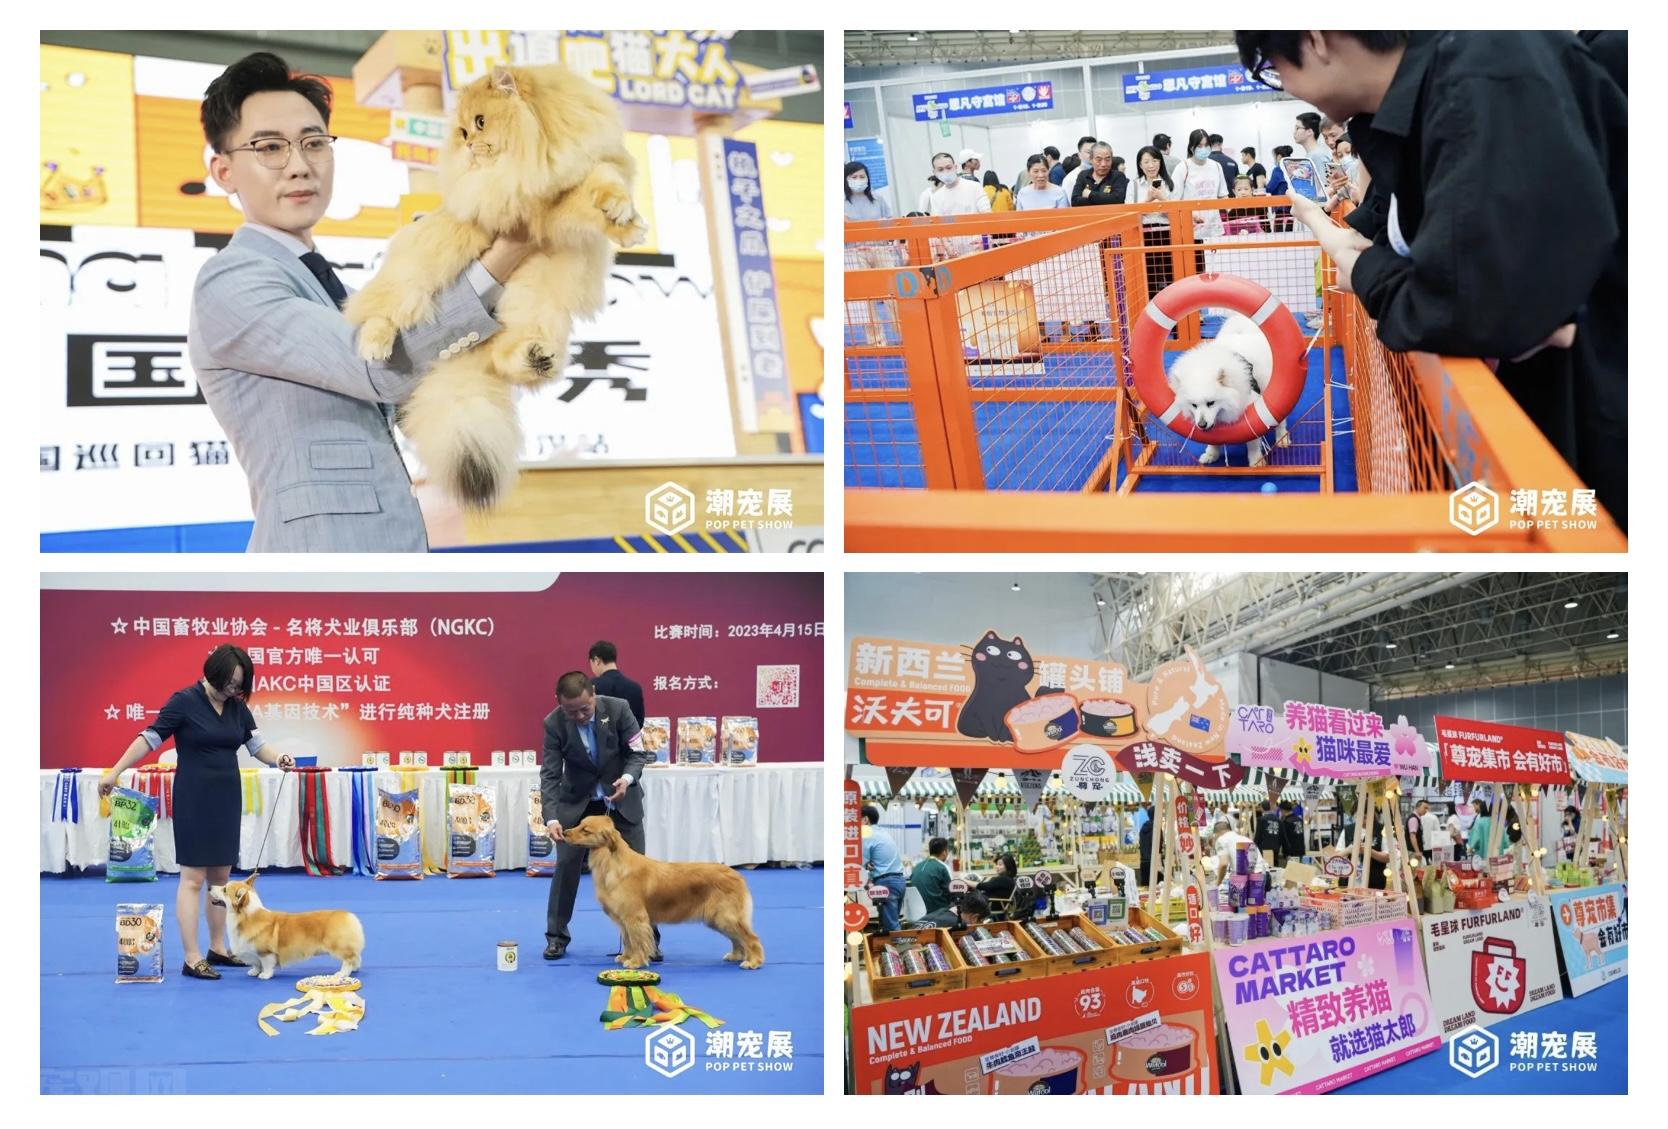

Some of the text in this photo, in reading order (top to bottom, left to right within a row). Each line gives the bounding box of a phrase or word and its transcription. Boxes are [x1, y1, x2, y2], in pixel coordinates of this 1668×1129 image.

[688, 83, 738, 110] CAT
[133, 616, 268, 637] 中国畜牧业协会
[855, 642, 966, 681] 新西兰
[1039, 661, 1124, 694] 罐头铺
[653, 674, 720, 691] 报名方式：
[854, 677, 897, 689] Complete
[359, 702, 490, 721] 进行纯种犬注册
[851, 694, 954, 729] 沃夫可
[1285, 702, 1384, 738] 养猫看过来
[1133, 742, 1232, 788] 浅卖一下
[1315, 735, 1391, 767] 猫咪最爱
[1430, 920, 1459, 937] 毛星球
[1461, 908, 1521, 931] FURFURLAND
[1573, 895, 1617, 928] 尊宠市集
[1598, 922, 1628, 948] 会有好市
[1228, 937, 1356, 978] CATTARO
[1235, 962, 1346, 1005] MARKET
[1080, 993, 1102, 1012] 93
[1287, 978, 1392, 1038] 精致养猫
[867, 997, 1042, 1054] NEW ZEALAND
[1443, 1011, 1476, 1027] DREAM LAND
[1444, 1016, 1476, 1033] DREAM FOOD
[869, 1035, 973, 1065] Complete & Balanced FOOD
[1329, 1013, 1416, 1063] 就选猫太郎
